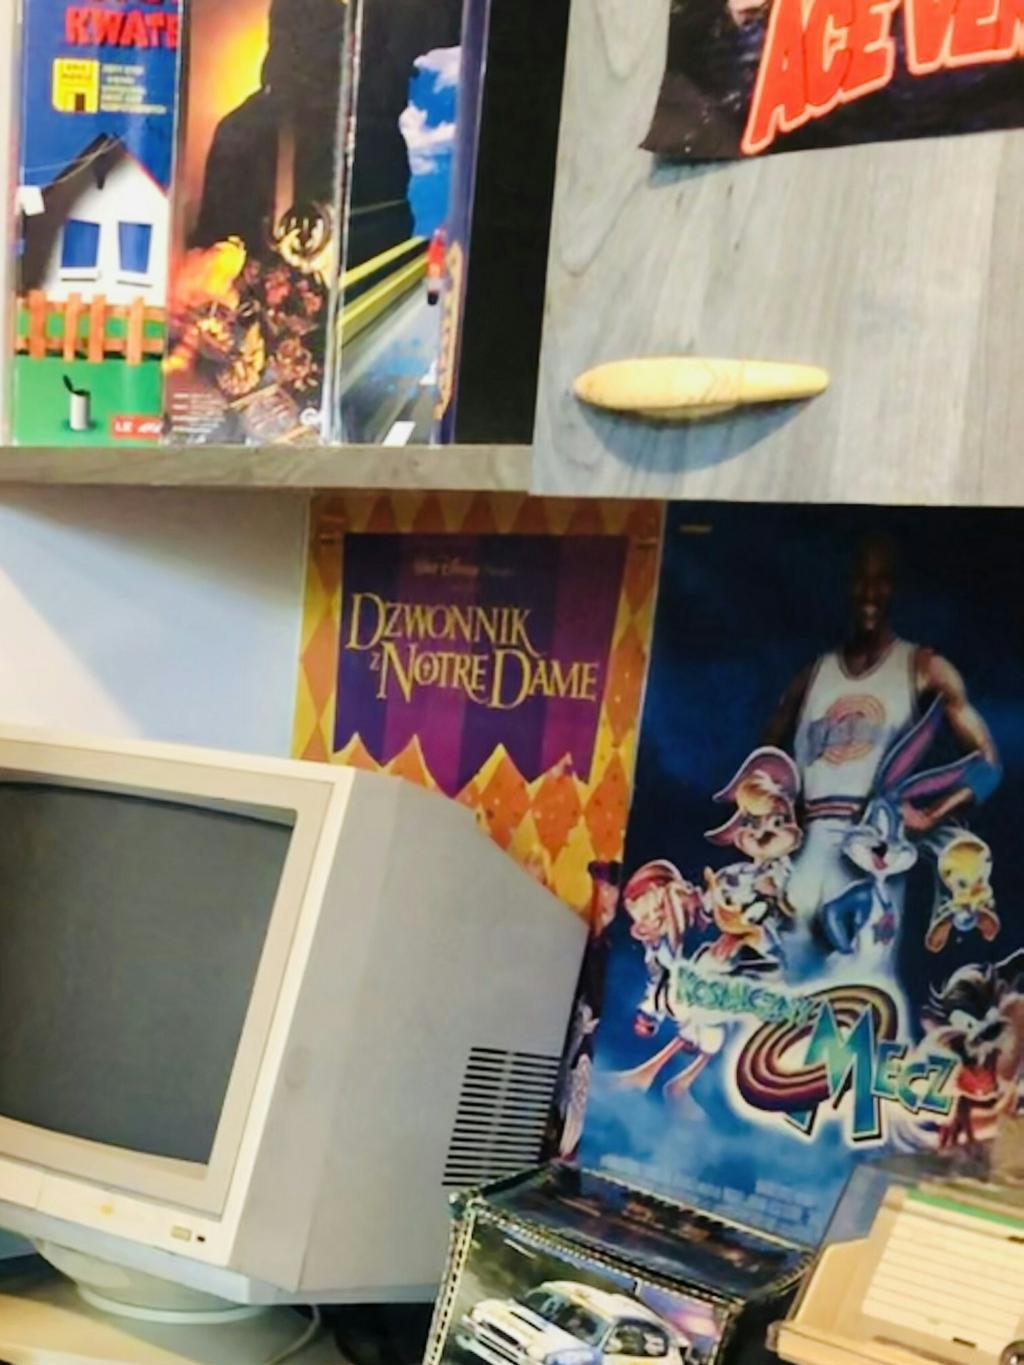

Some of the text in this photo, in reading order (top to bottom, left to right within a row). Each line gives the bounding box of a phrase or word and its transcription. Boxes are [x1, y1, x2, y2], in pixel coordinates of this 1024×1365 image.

[345, 592, 541, 658] DZWONNIK
[377, 640, 489, 705] NOTRE
[487, 648, 600, 710] DAME
